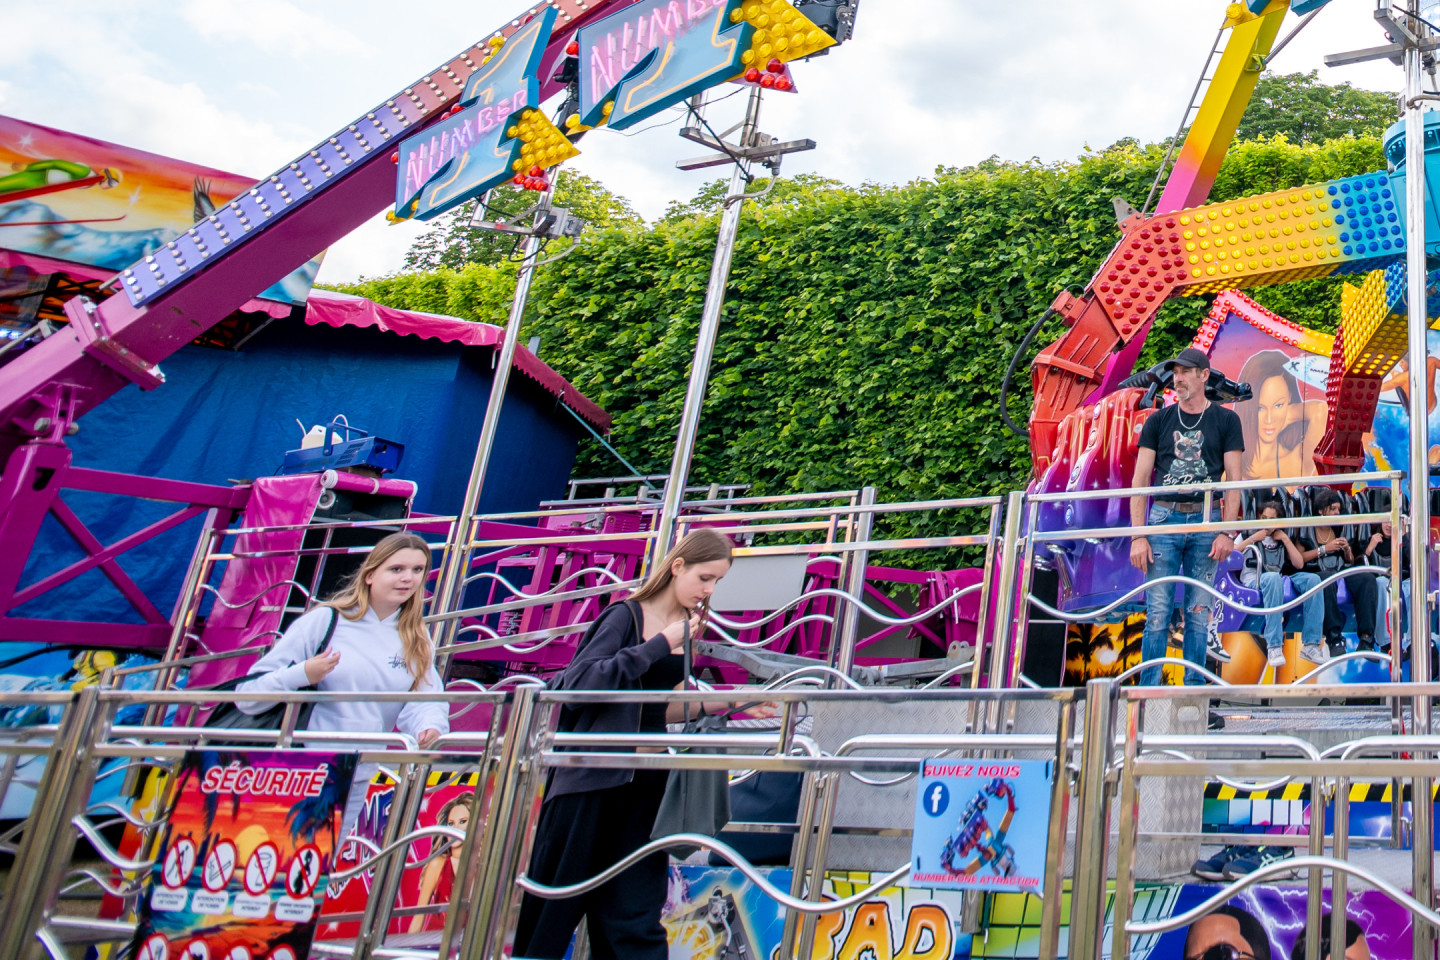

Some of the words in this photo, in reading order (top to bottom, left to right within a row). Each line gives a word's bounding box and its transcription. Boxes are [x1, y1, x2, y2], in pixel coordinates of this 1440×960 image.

[403, 89, 528, 204] NUMBER
[201, 760, 329, 797] SÉCURITÉ
[924, 764, 974, 778] SUIVEZ
[977, 765, 1021, 778] NOUS
